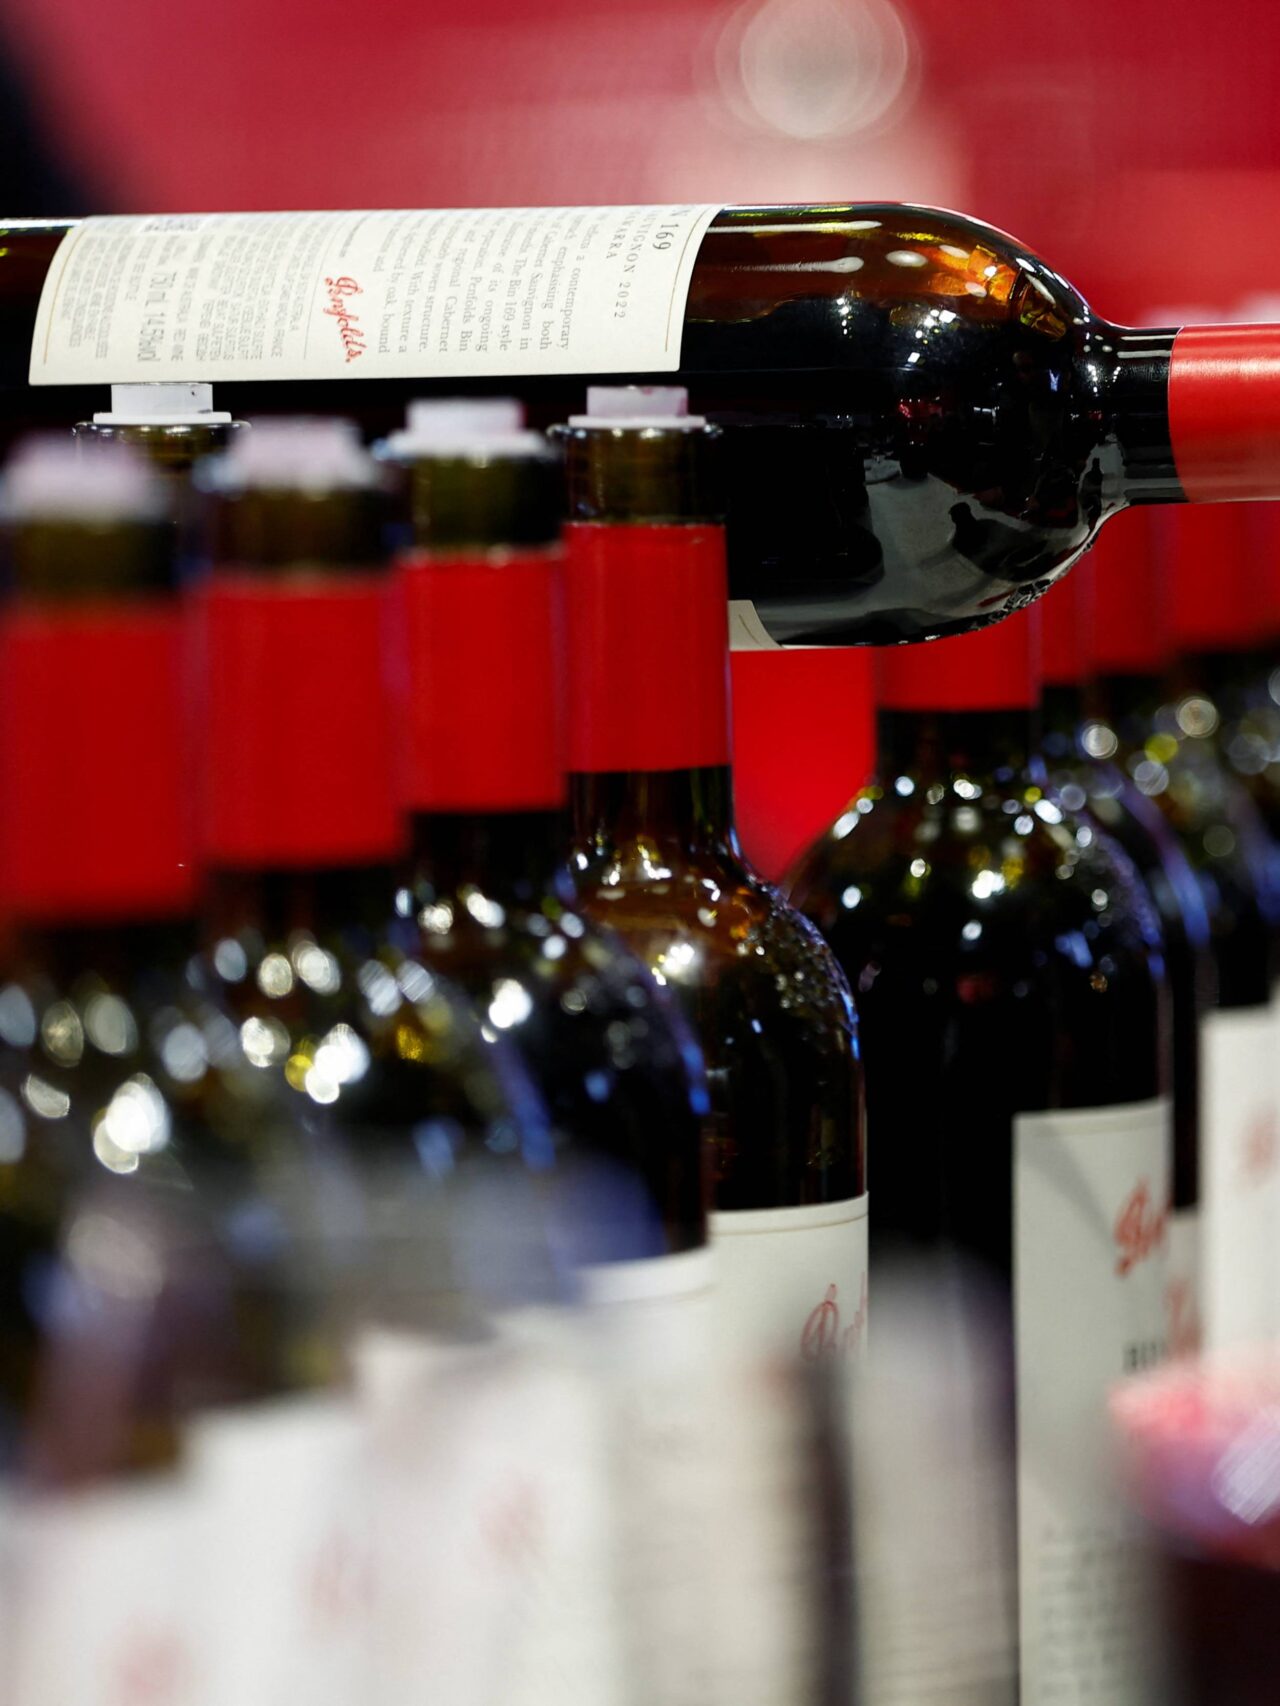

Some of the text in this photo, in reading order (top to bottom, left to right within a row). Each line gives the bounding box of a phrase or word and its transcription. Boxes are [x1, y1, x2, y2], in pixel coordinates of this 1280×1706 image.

[649, 223, 682, 249] 169
[490, 262, 506, 274] of
[509, 256, 529, 277] The
[539, 245, 571, 309] emphasising
[405, 271, 425, 296] With
[486, 279, 502, 292] its
[505, 279, 521, 297] Bin
[460, 275, 483, 324] Penfolds
[502, 302, 517, 321] 169
[517, 271, 543, 330] Sauvignon
[555, 267, 582, 350] contemporary
[613, 280, 631, 318] 2022
[376, 313, 395, 353] bound
[399, 298, 416, 342] texture
[416, 295, 436, 353] structure.
[437, 294, 459, 353] Cabernet
[473, 299, 497, 352] ongoing
[396, 344, 409, 353] a
[457, 330, 474, 352] Bin
[493, 323, 514, 351] style
[519, 337, 533, 350] in
[539, 320, 554, 350] both
